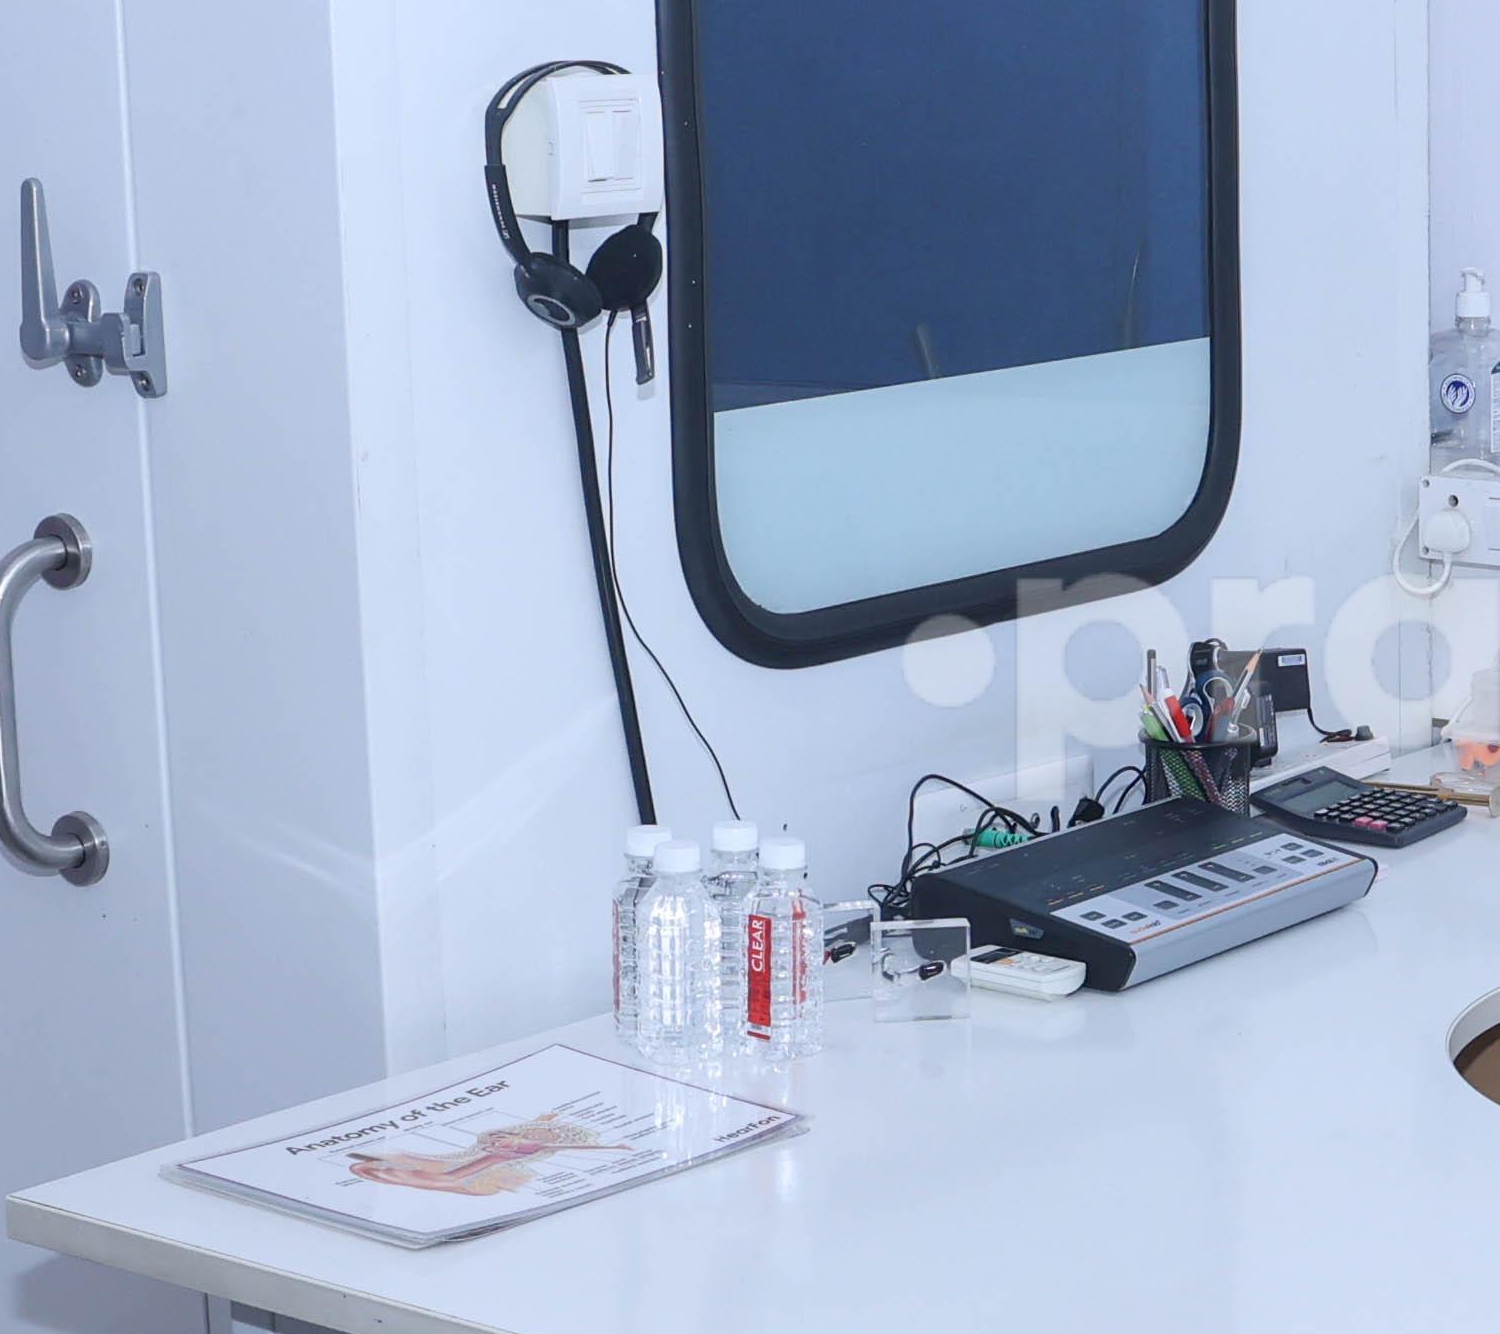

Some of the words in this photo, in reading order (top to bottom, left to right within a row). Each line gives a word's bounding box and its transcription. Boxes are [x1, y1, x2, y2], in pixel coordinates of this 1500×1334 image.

[751, 919, 764, 972] CLEAR
[285, 1118, 398, 1156] Anatomy
[400, 1107, 428, 1122] of
[427, 1094, 472, 1113] the
[467, 1079, 512, 1098] Ear
